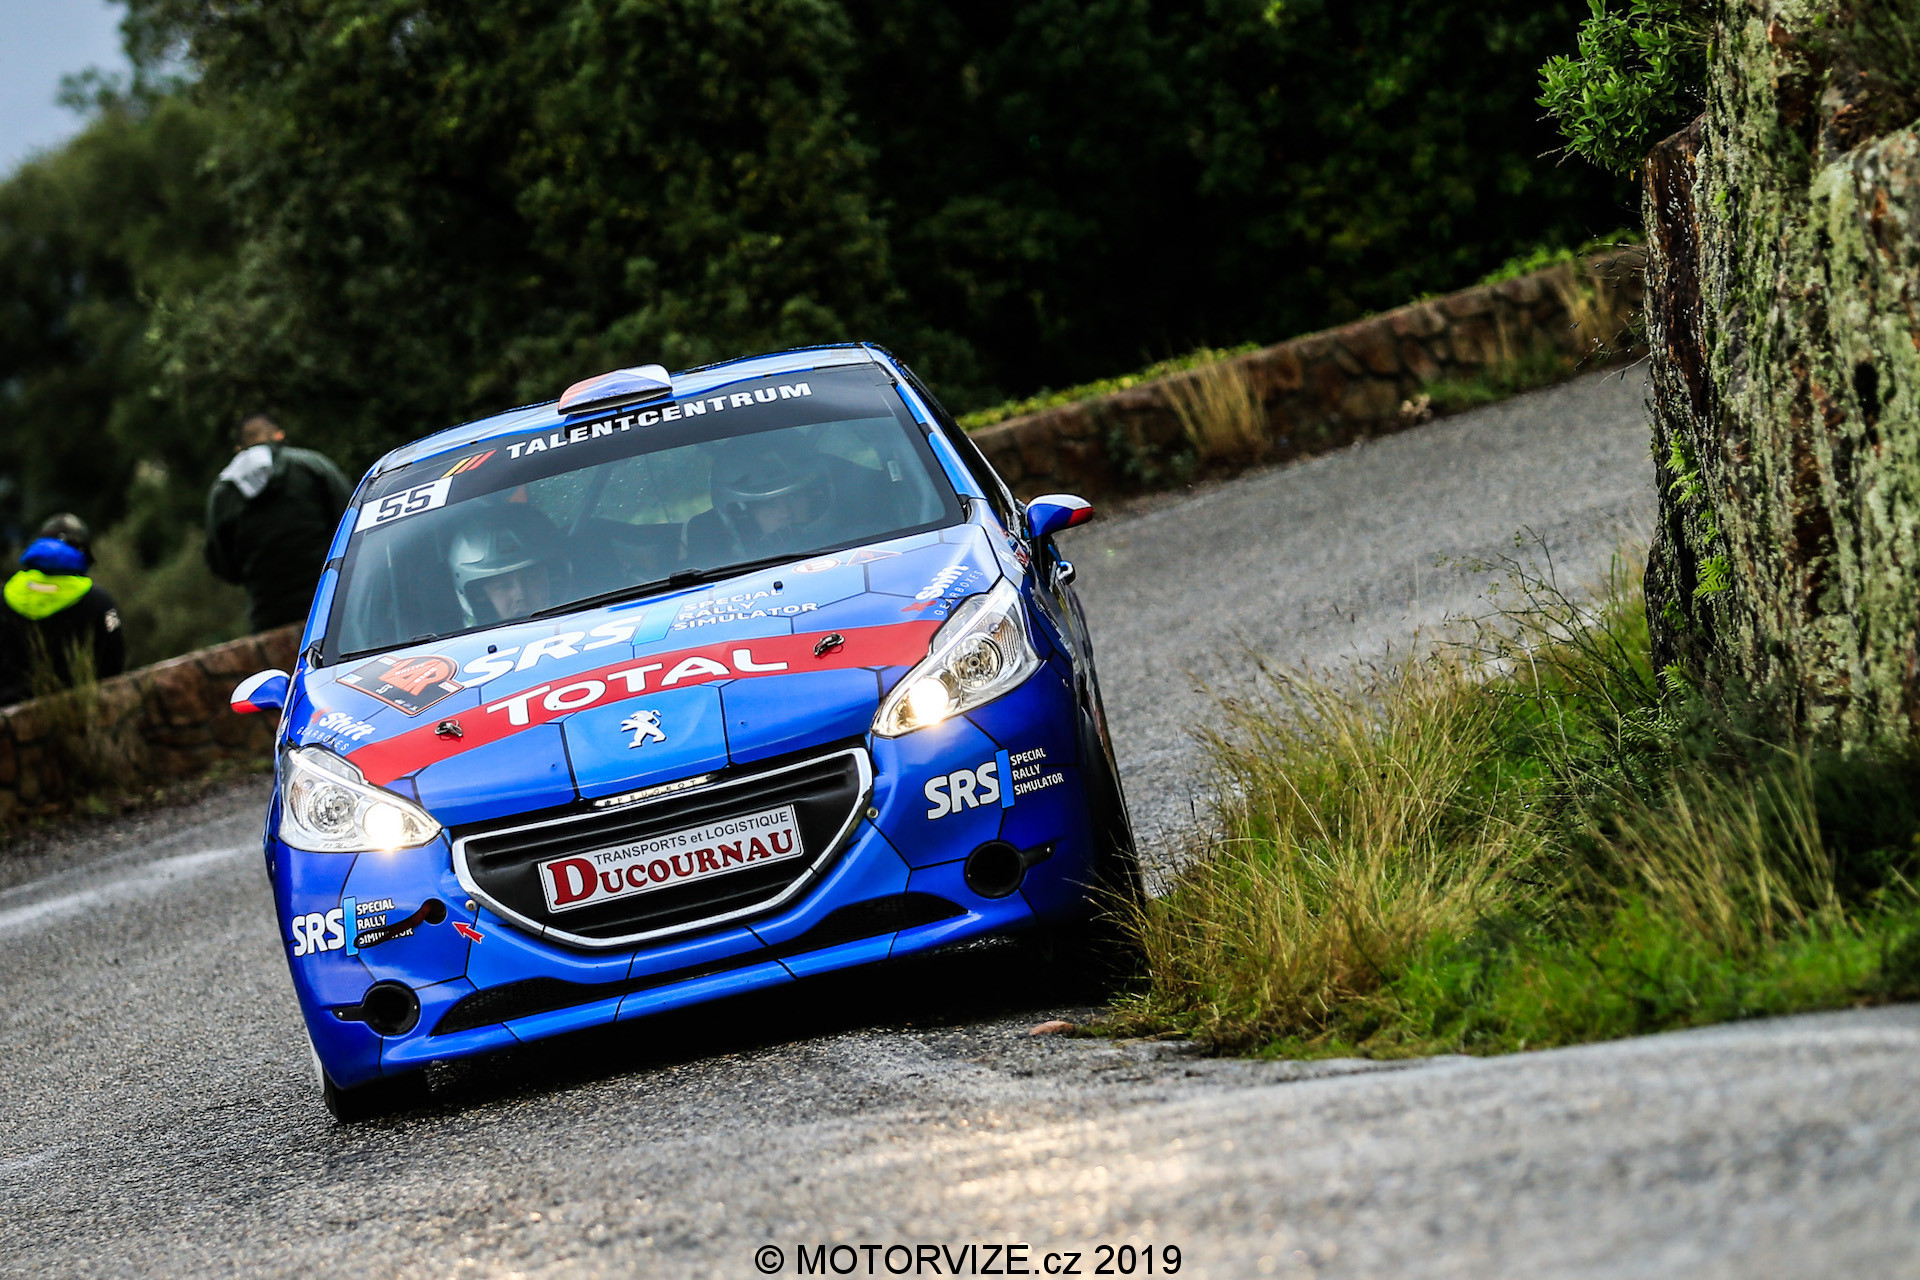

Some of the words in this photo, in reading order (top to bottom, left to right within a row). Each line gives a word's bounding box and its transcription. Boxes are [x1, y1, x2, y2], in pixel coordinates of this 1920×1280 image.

[506, 382, 813, 459] TALENTCENTRUM
[376, 483, 436, 522] 55
[915, 565, 969, 600] Shift
[934, 570, 984, 616] GEARBOXES
[679, 601, 757, 621] RALLY
[684, 589, 784, 612] SPECIAL
[674, 603, 819, 631] SIMULATOR
[459, 614, 643, 688] SRS
[487, 649, 788, 726] TOTAL
[296, 726, 350, 751] GEARBOXES
[319, 712, 376, 741] Shift
[1010, 748, 1046, 766] SPECIAL
[1012, 764, 1041, 781] RALLY
[1014, 773, 1064, 796] SIMULATOR
[617, 780, 697, 804] PEUGEOT
[924, 761, 1000, 820] SRS
[594, 834, 687, 866] TRANSPORTS
[690, 832, 703, 844] et
[705, 811, 789, 840] LOGISTIQUE
[547, 829, 794, 905] DUCOURNAU
[356, 899, 395, 915] SPECIAL
[292, 908, 345, 957] SRS
[357, 915, 386, 930] RALLY
